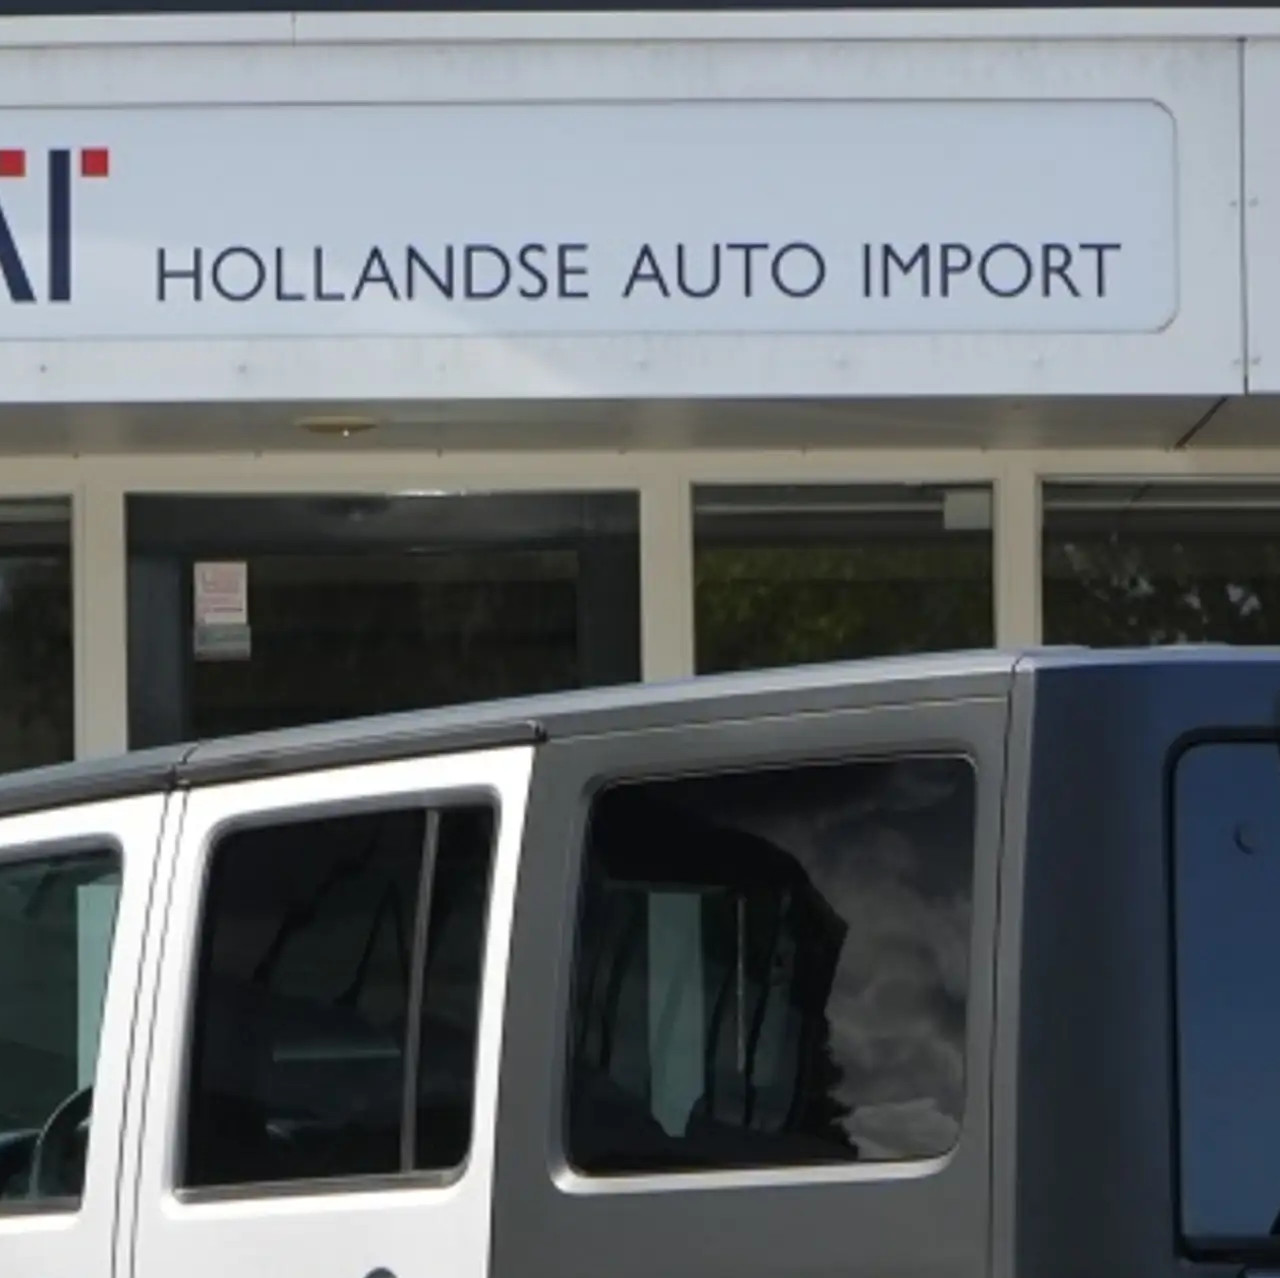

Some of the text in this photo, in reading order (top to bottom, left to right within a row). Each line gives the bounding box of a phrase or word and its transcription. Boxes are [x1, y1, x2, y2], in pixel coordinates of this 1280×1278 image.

[157, 241, 1122, 302] HOLLANDSE AUTO IMPORT
